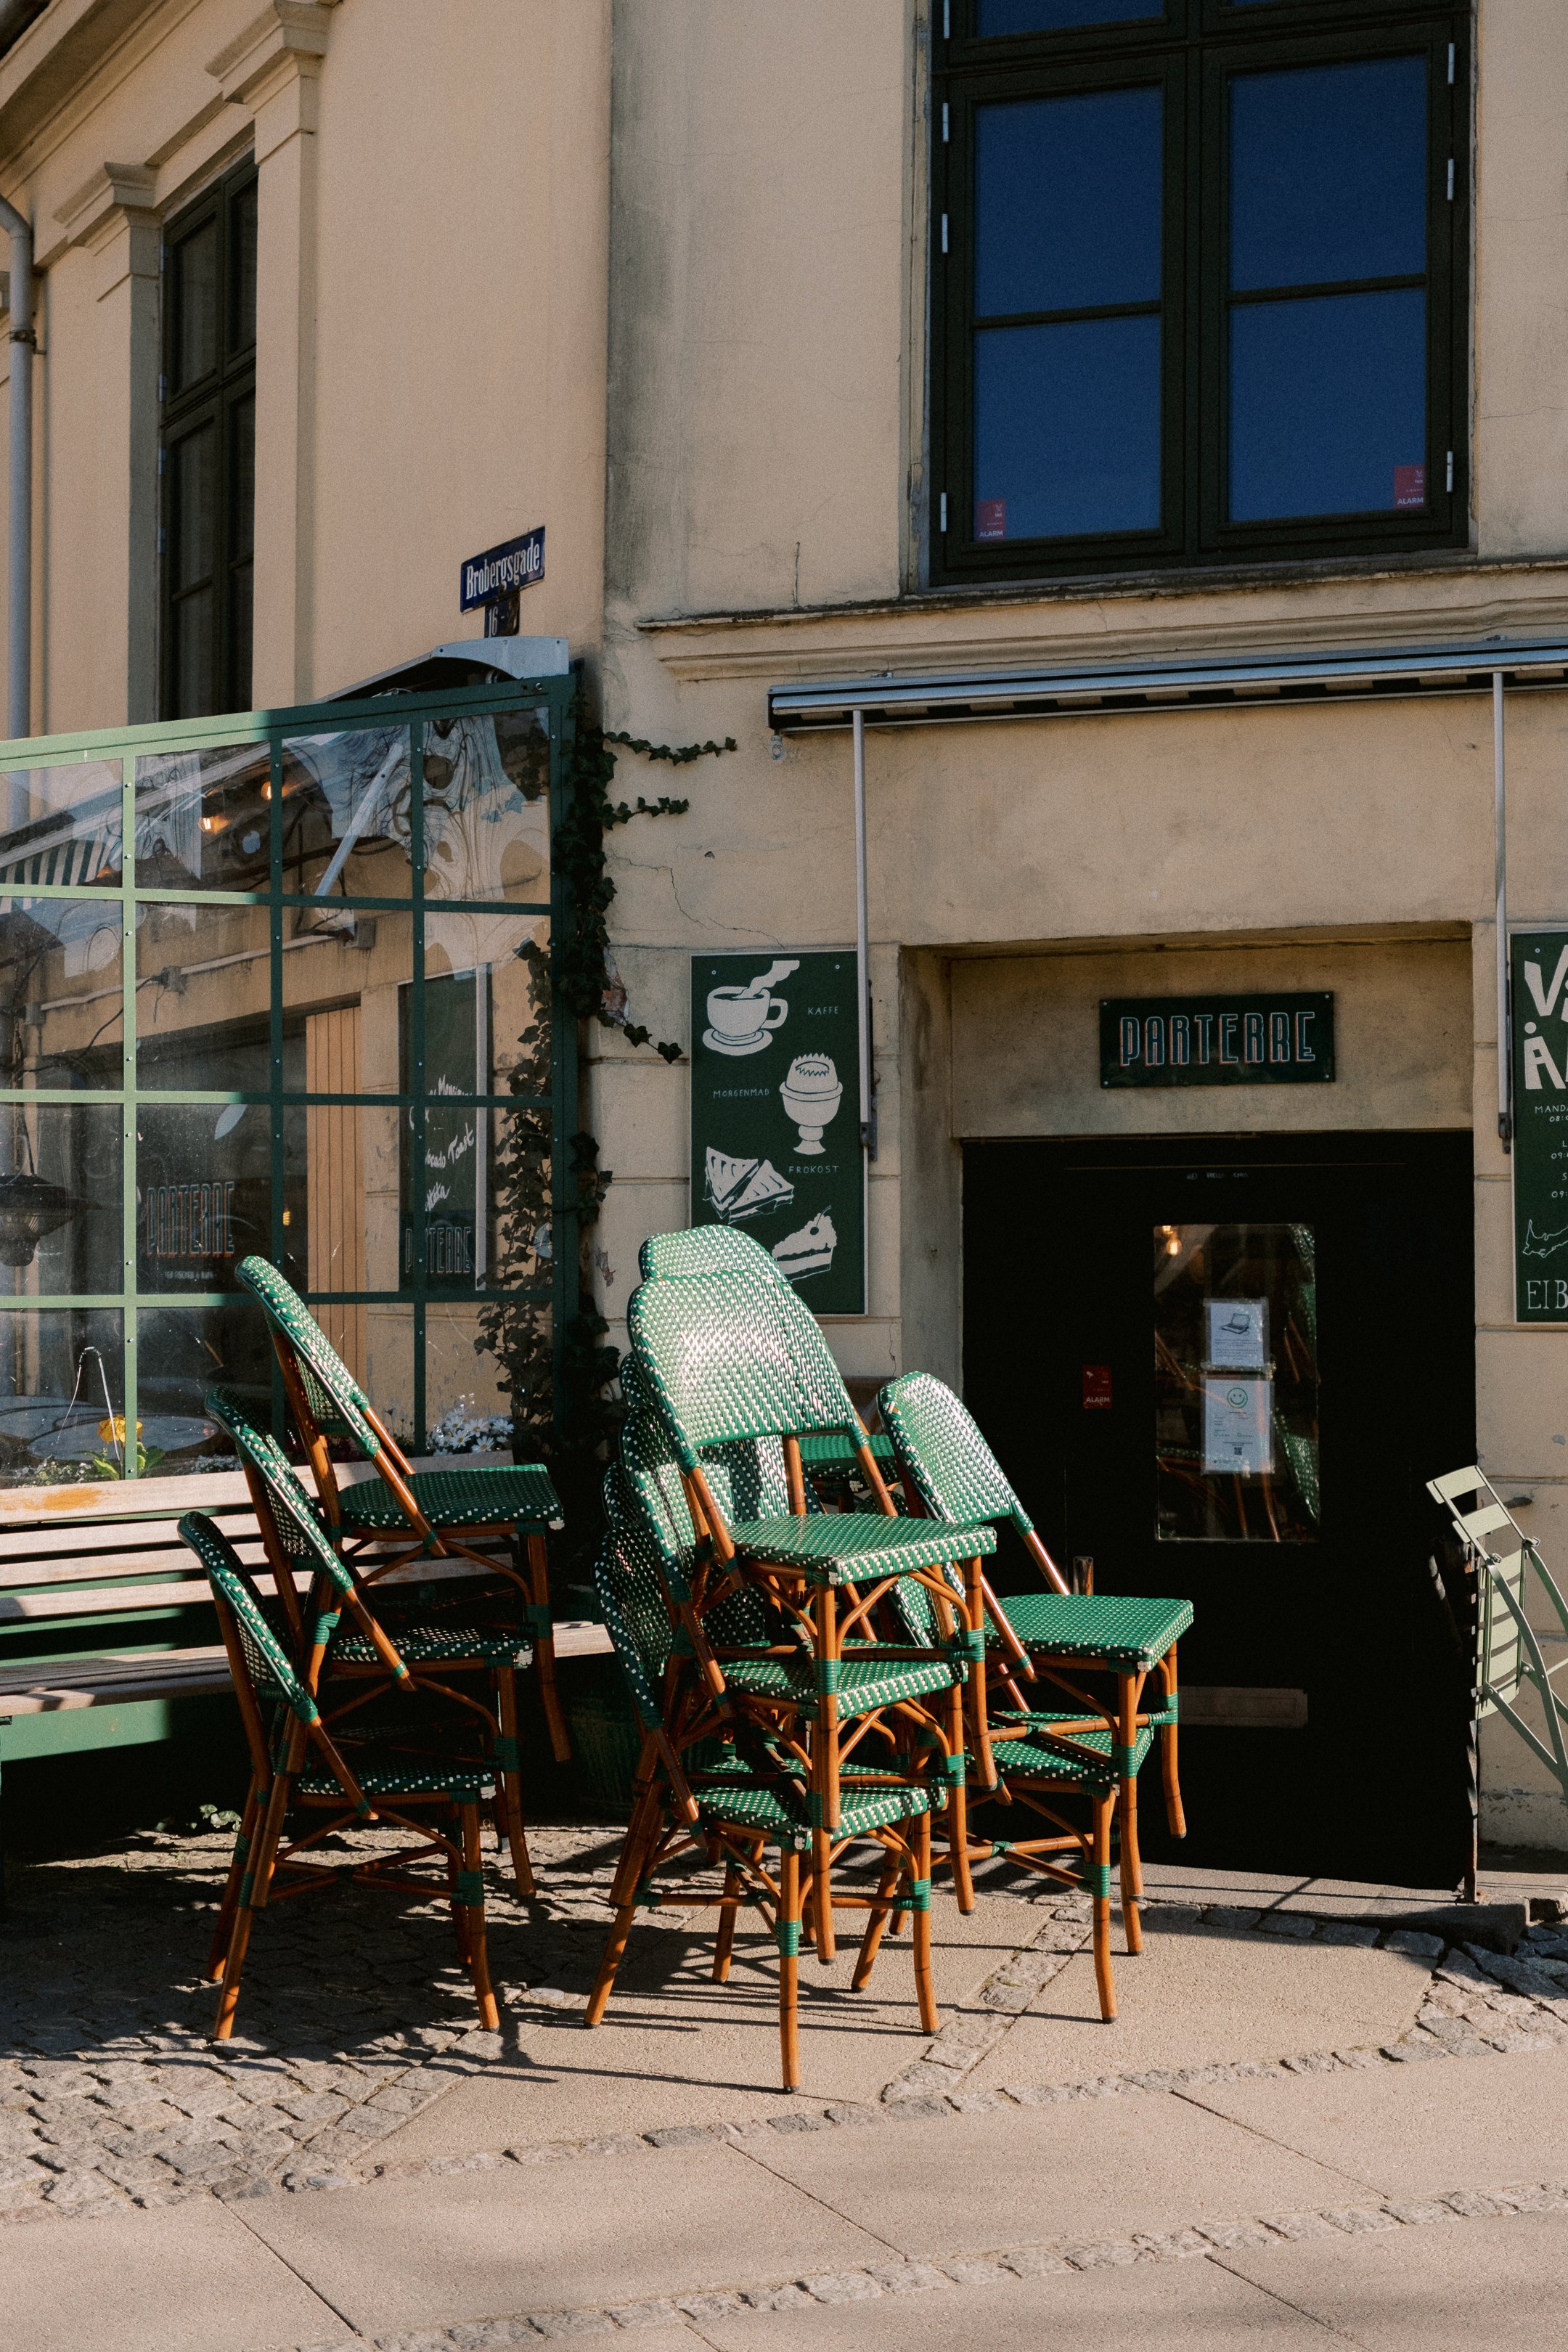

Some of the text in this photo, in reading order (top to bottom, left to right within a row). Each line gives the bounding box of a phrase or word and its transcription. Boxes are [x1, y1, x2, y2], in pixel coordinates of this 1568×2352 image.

[466, 538, 539, 599] Brobergsgade
[808, 1006, 839, 1015] KAFFE
[1119, 1012, 1315, 1067] PARTERRE
[713, 1088, 769, 1098] MORGENMAD
[448, 1122, 474, 1164] Toast
[147, 1181, 234, 1258] PARTERRE
[406, 1227, 470, 1274] PTERRE
